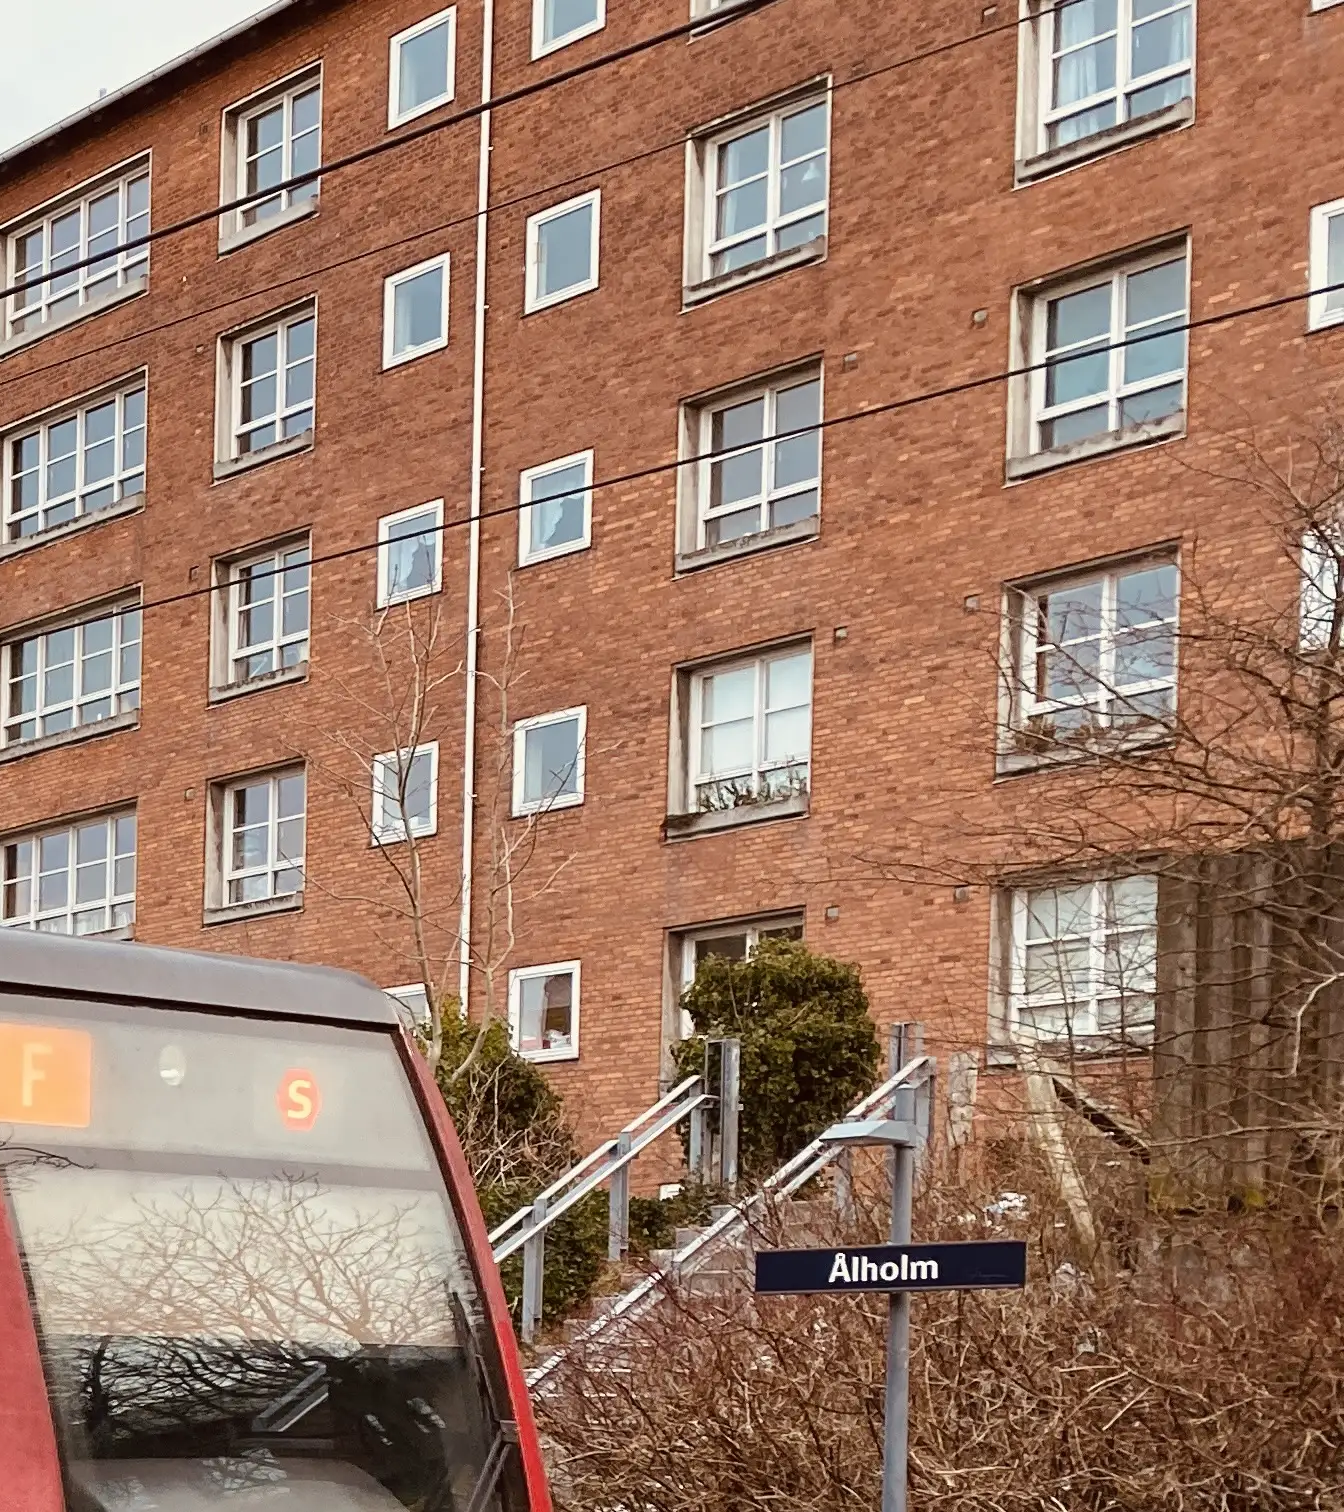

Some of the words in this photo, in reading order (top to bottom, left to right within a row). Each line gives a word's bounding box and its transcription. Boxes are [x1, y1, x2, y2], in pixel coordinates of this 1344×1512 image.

[21, 1042, 54, 1108] F
[287, 1079, 313, 1120] S
[828, 1252, 939, 1283] Ålholm
